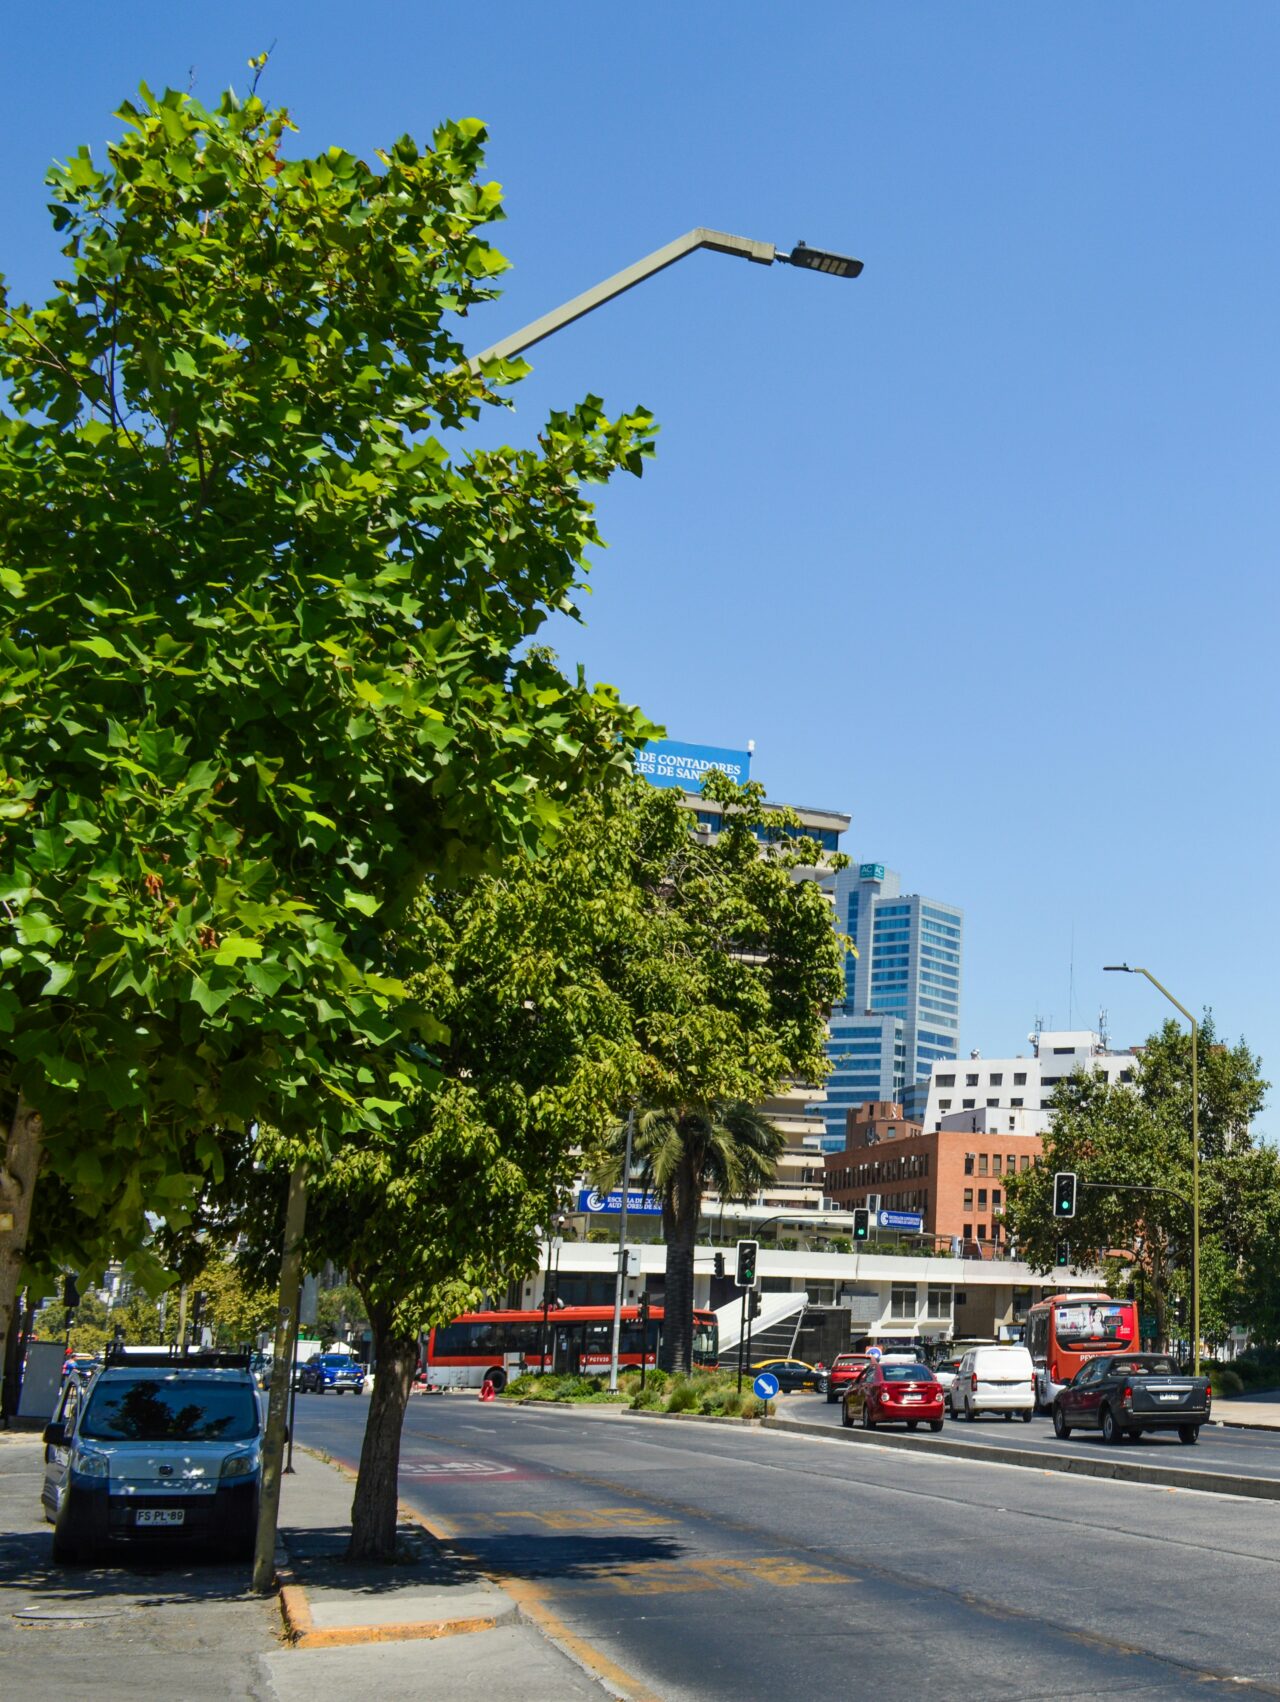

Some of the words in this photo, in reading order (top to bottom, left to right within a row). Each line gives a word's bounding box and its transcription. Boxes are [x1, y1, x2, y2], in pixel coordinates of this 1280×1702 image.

[639, 751, 657, 763] DE
[658, 754, 741, 775] CONTADORES
[657, 765, 674, 777] DE
[138, 1511, 151, 1521] FS
